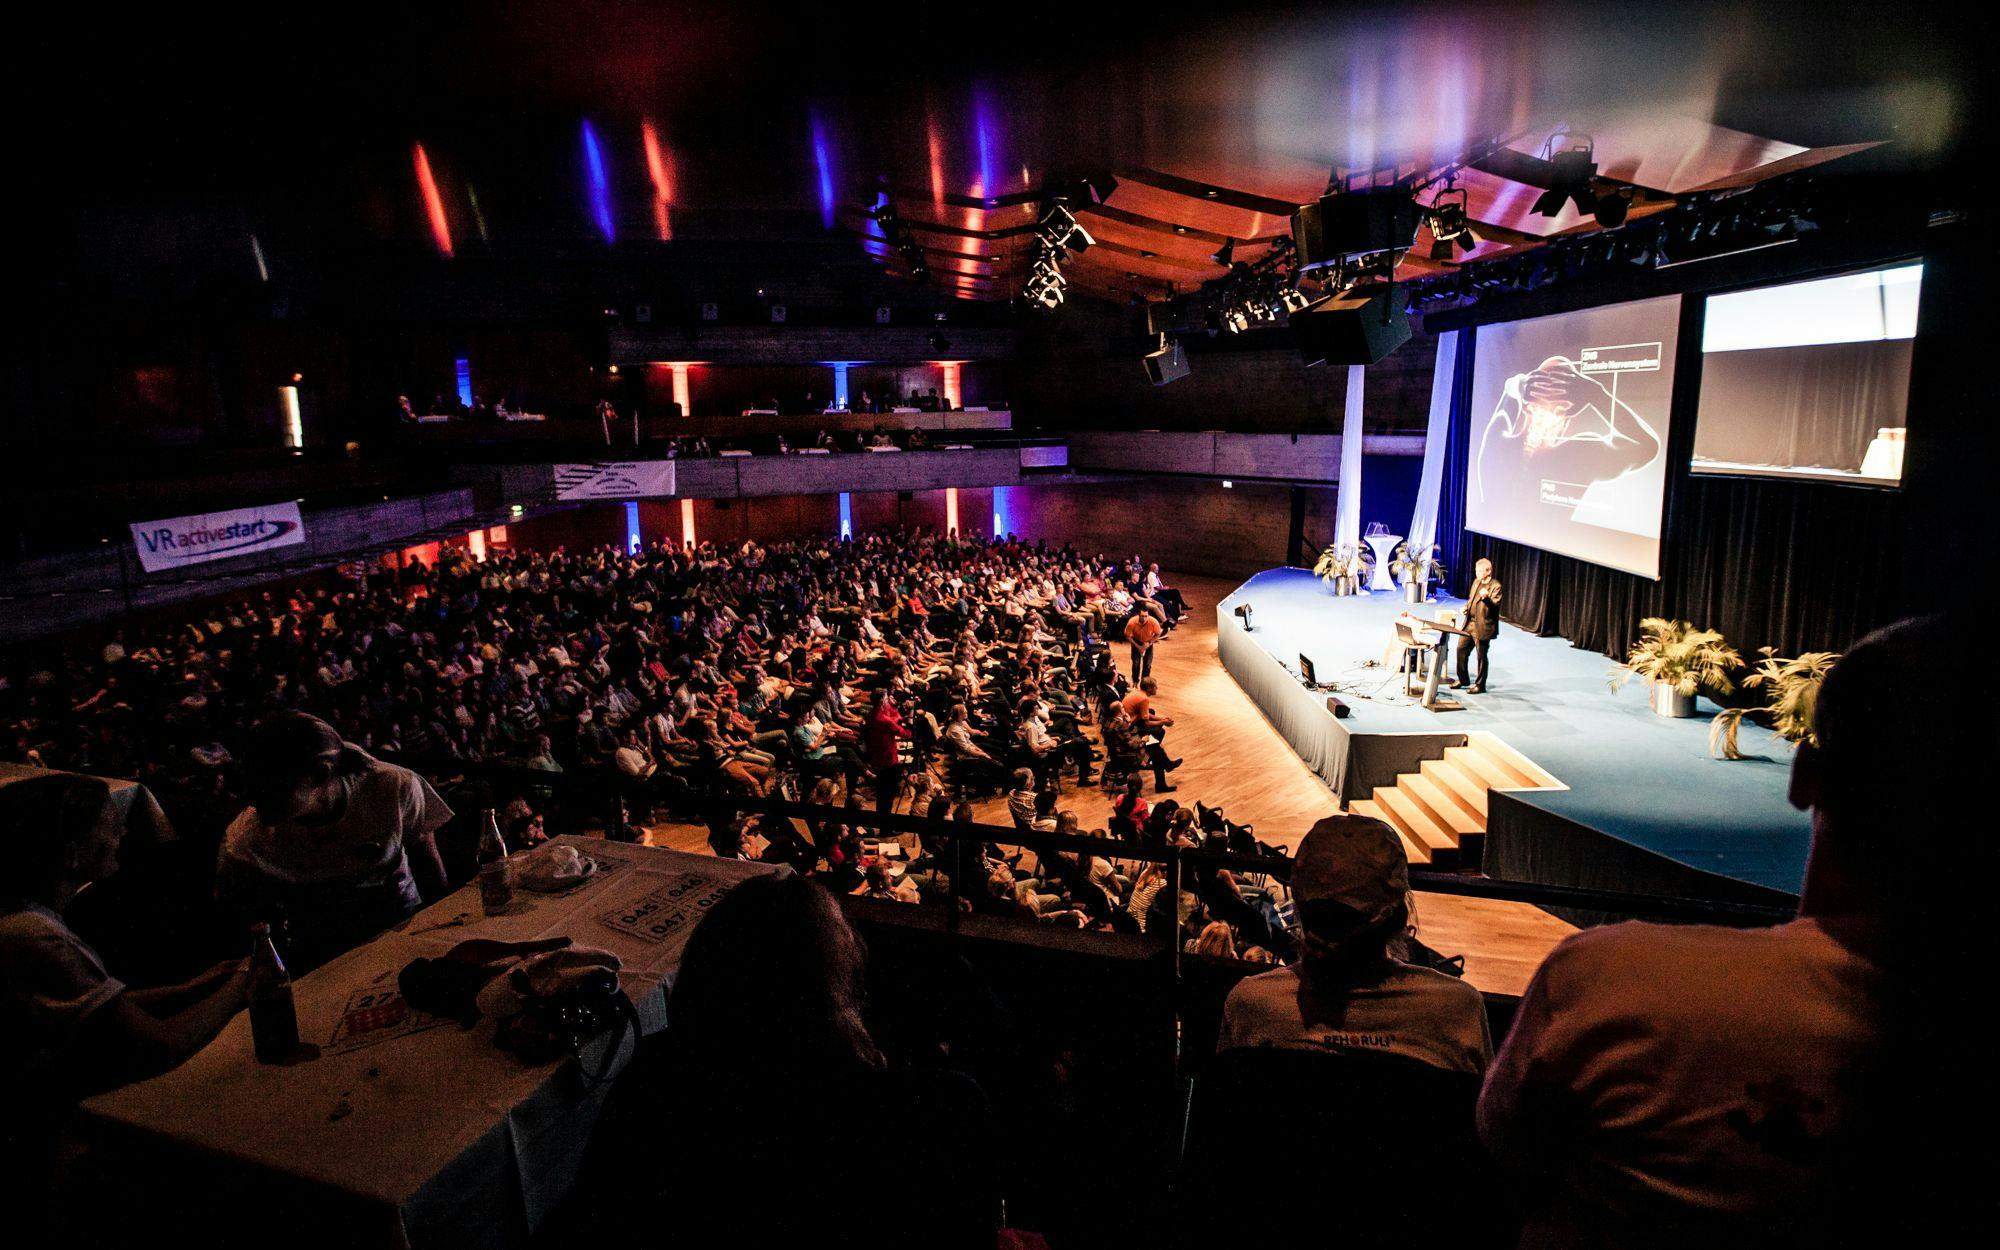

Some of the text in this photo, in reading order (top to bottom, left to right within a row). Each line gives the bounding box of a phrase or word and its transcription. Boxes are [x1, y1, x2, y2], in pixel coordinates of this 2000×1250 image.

[140, 518, 265, 553] VR activestart
[668, 878, 704, 897] 046
[621, 903, 658, 923] 045
[651, 912, 685, 933] 047
